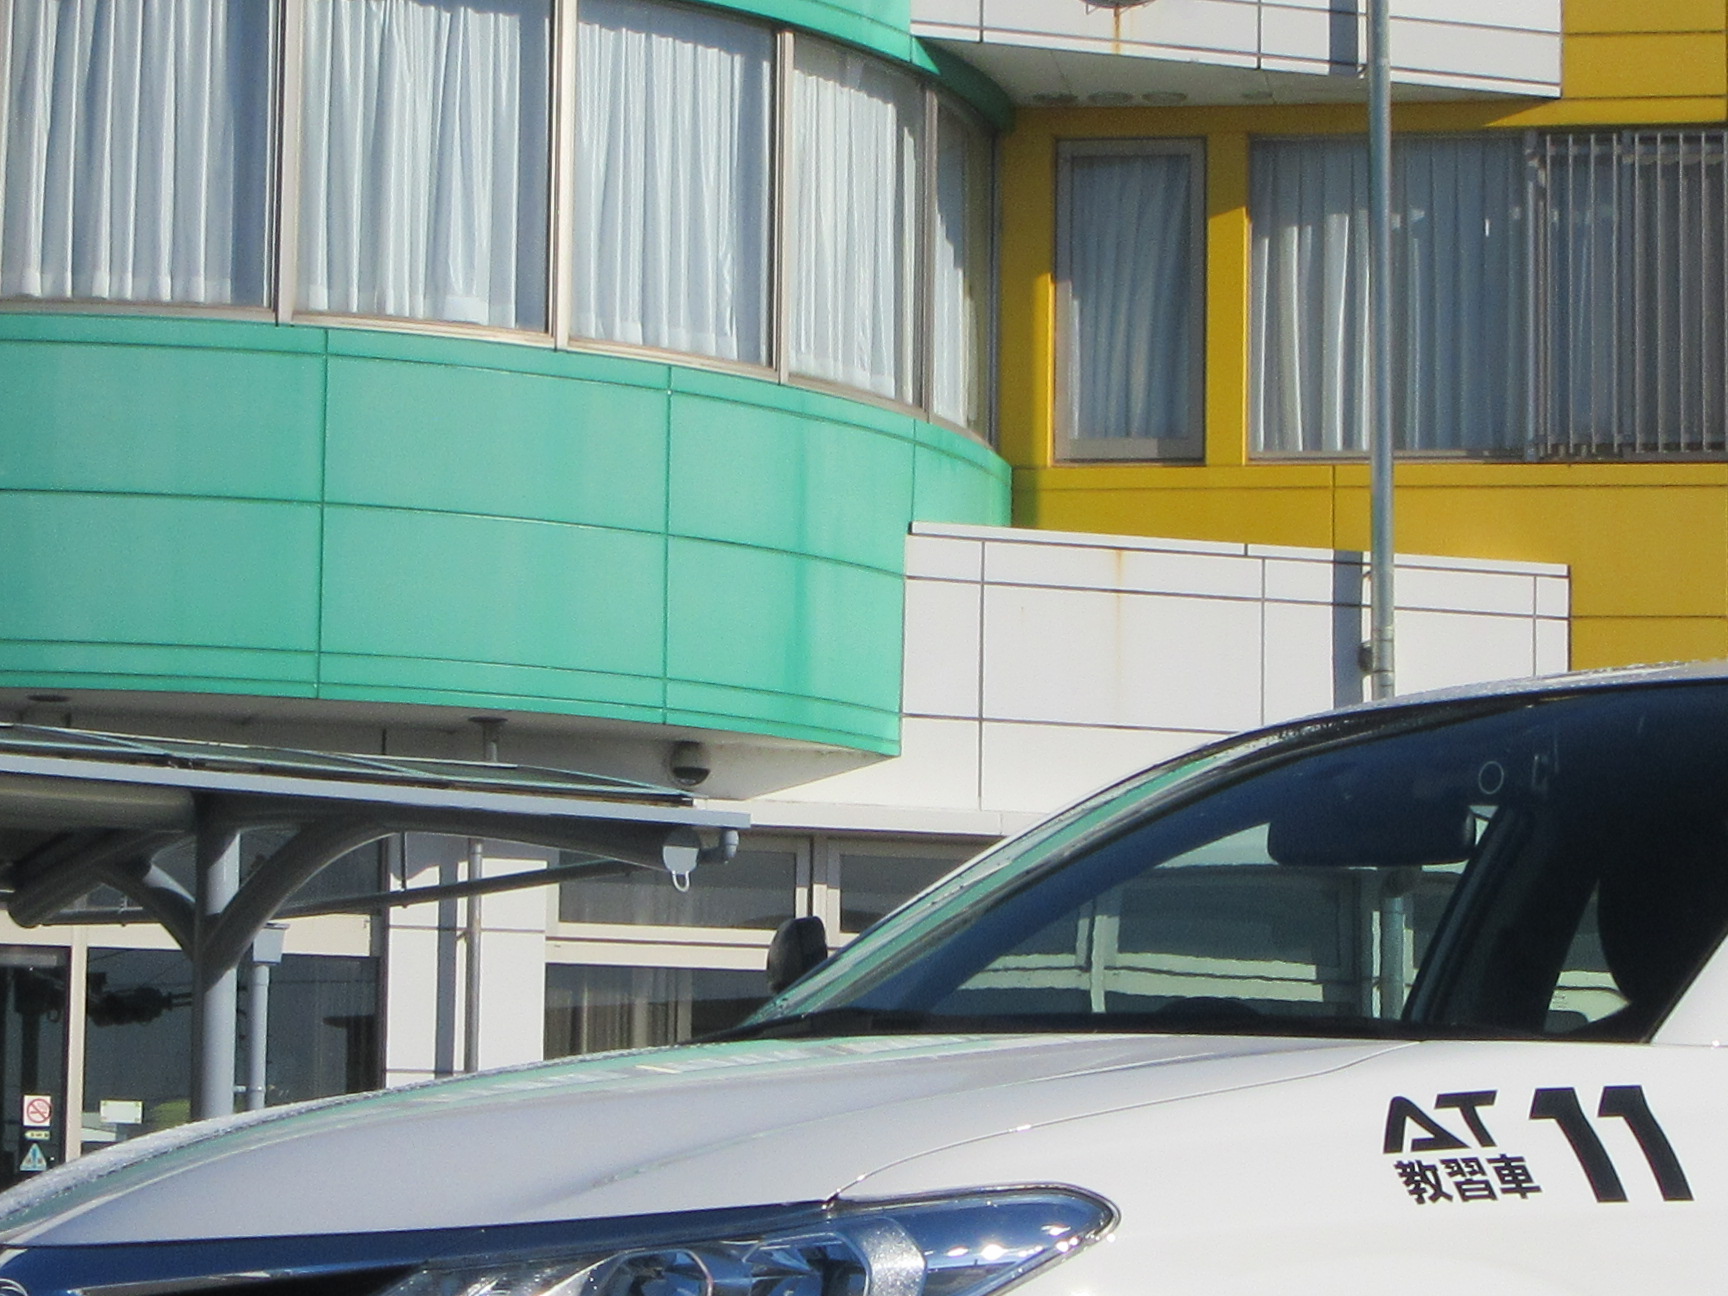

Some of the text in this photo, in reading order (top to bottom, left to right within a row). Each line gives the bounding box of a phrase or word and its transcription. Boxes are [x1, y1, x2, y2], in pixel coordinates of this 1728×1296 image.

[1383, 1084, 1694, 1203] AT 11
[1393, 1153, 1543, 1205] 教習車
